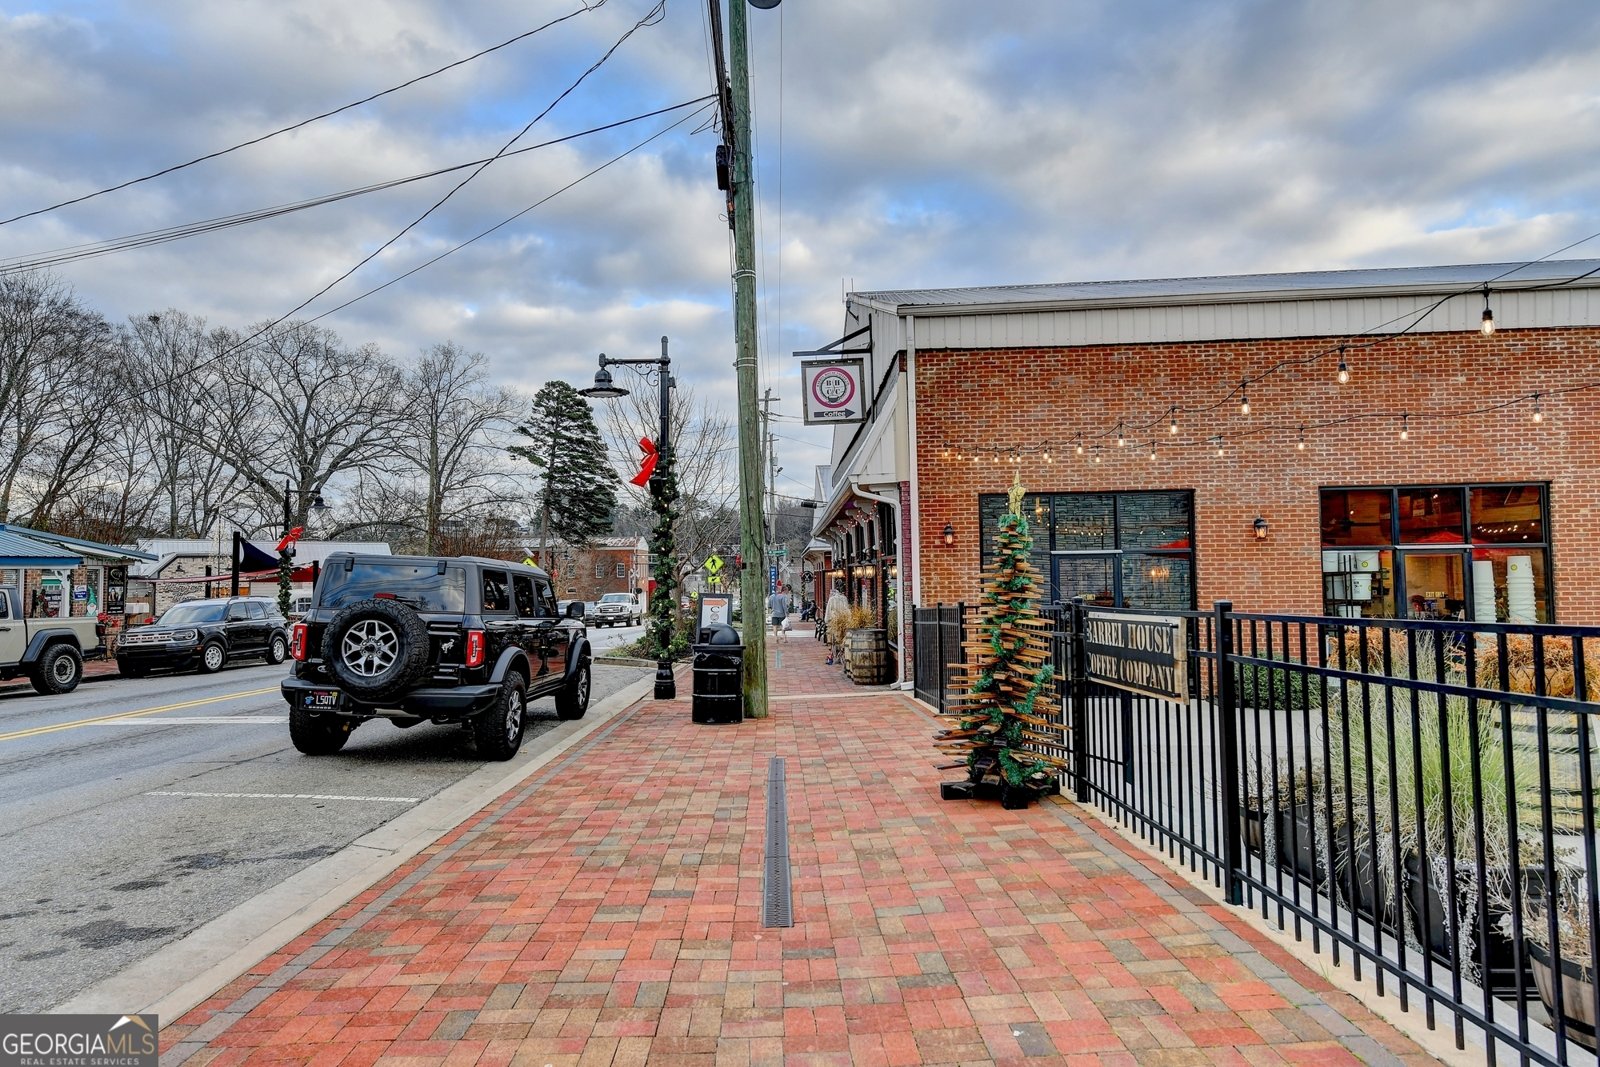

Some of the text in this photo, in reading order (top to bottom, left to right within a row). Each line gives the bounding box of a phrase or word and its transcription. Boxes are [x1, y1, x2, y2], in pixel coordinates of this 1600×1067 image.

[1086, 620, 1171, 654] BARREL HOUSE
[1085, 652, 1173, 692] COFFEE COMPANY
